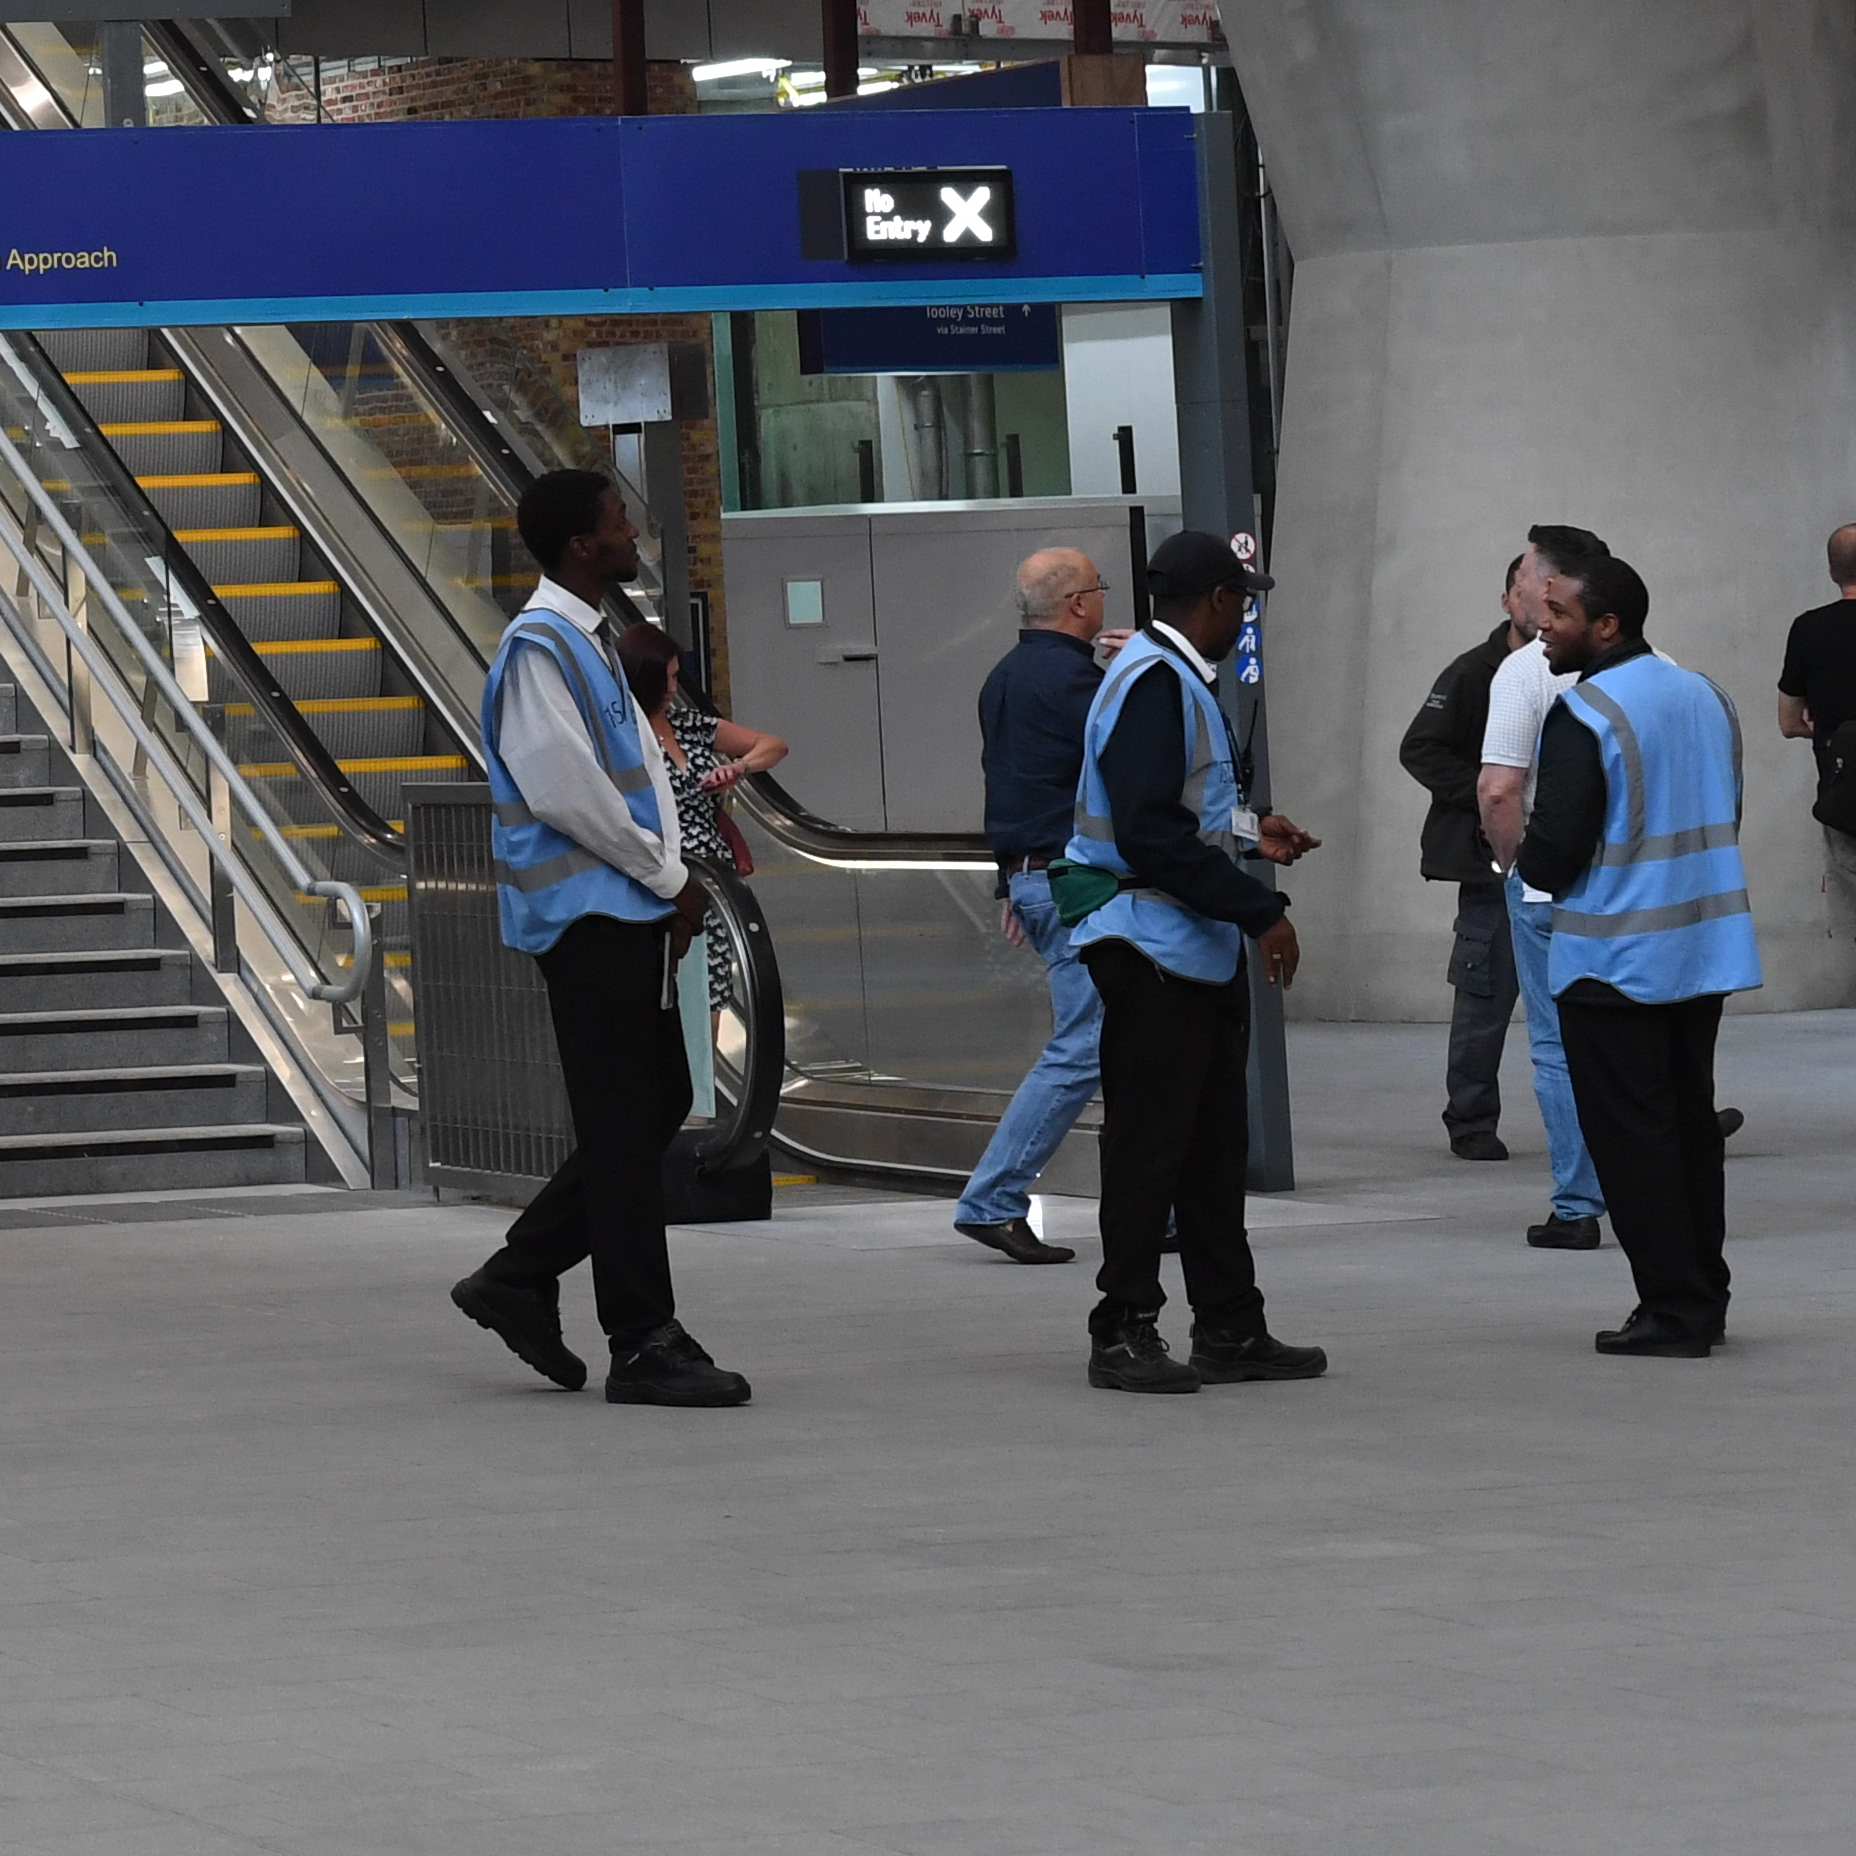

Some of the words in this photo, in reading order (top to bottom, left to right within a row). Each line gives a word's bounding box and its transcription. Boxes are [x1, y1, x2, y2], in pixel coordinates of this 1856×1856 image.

[906, 8, 943, 27] Tyvek
[864, 188, 895, 213] No
[866, 215, 932, 243] Entry
[6, 246, 117, 275] Approach
[967, 305, 1005, 319] Street
[980, 324, 1006, 334] Street
